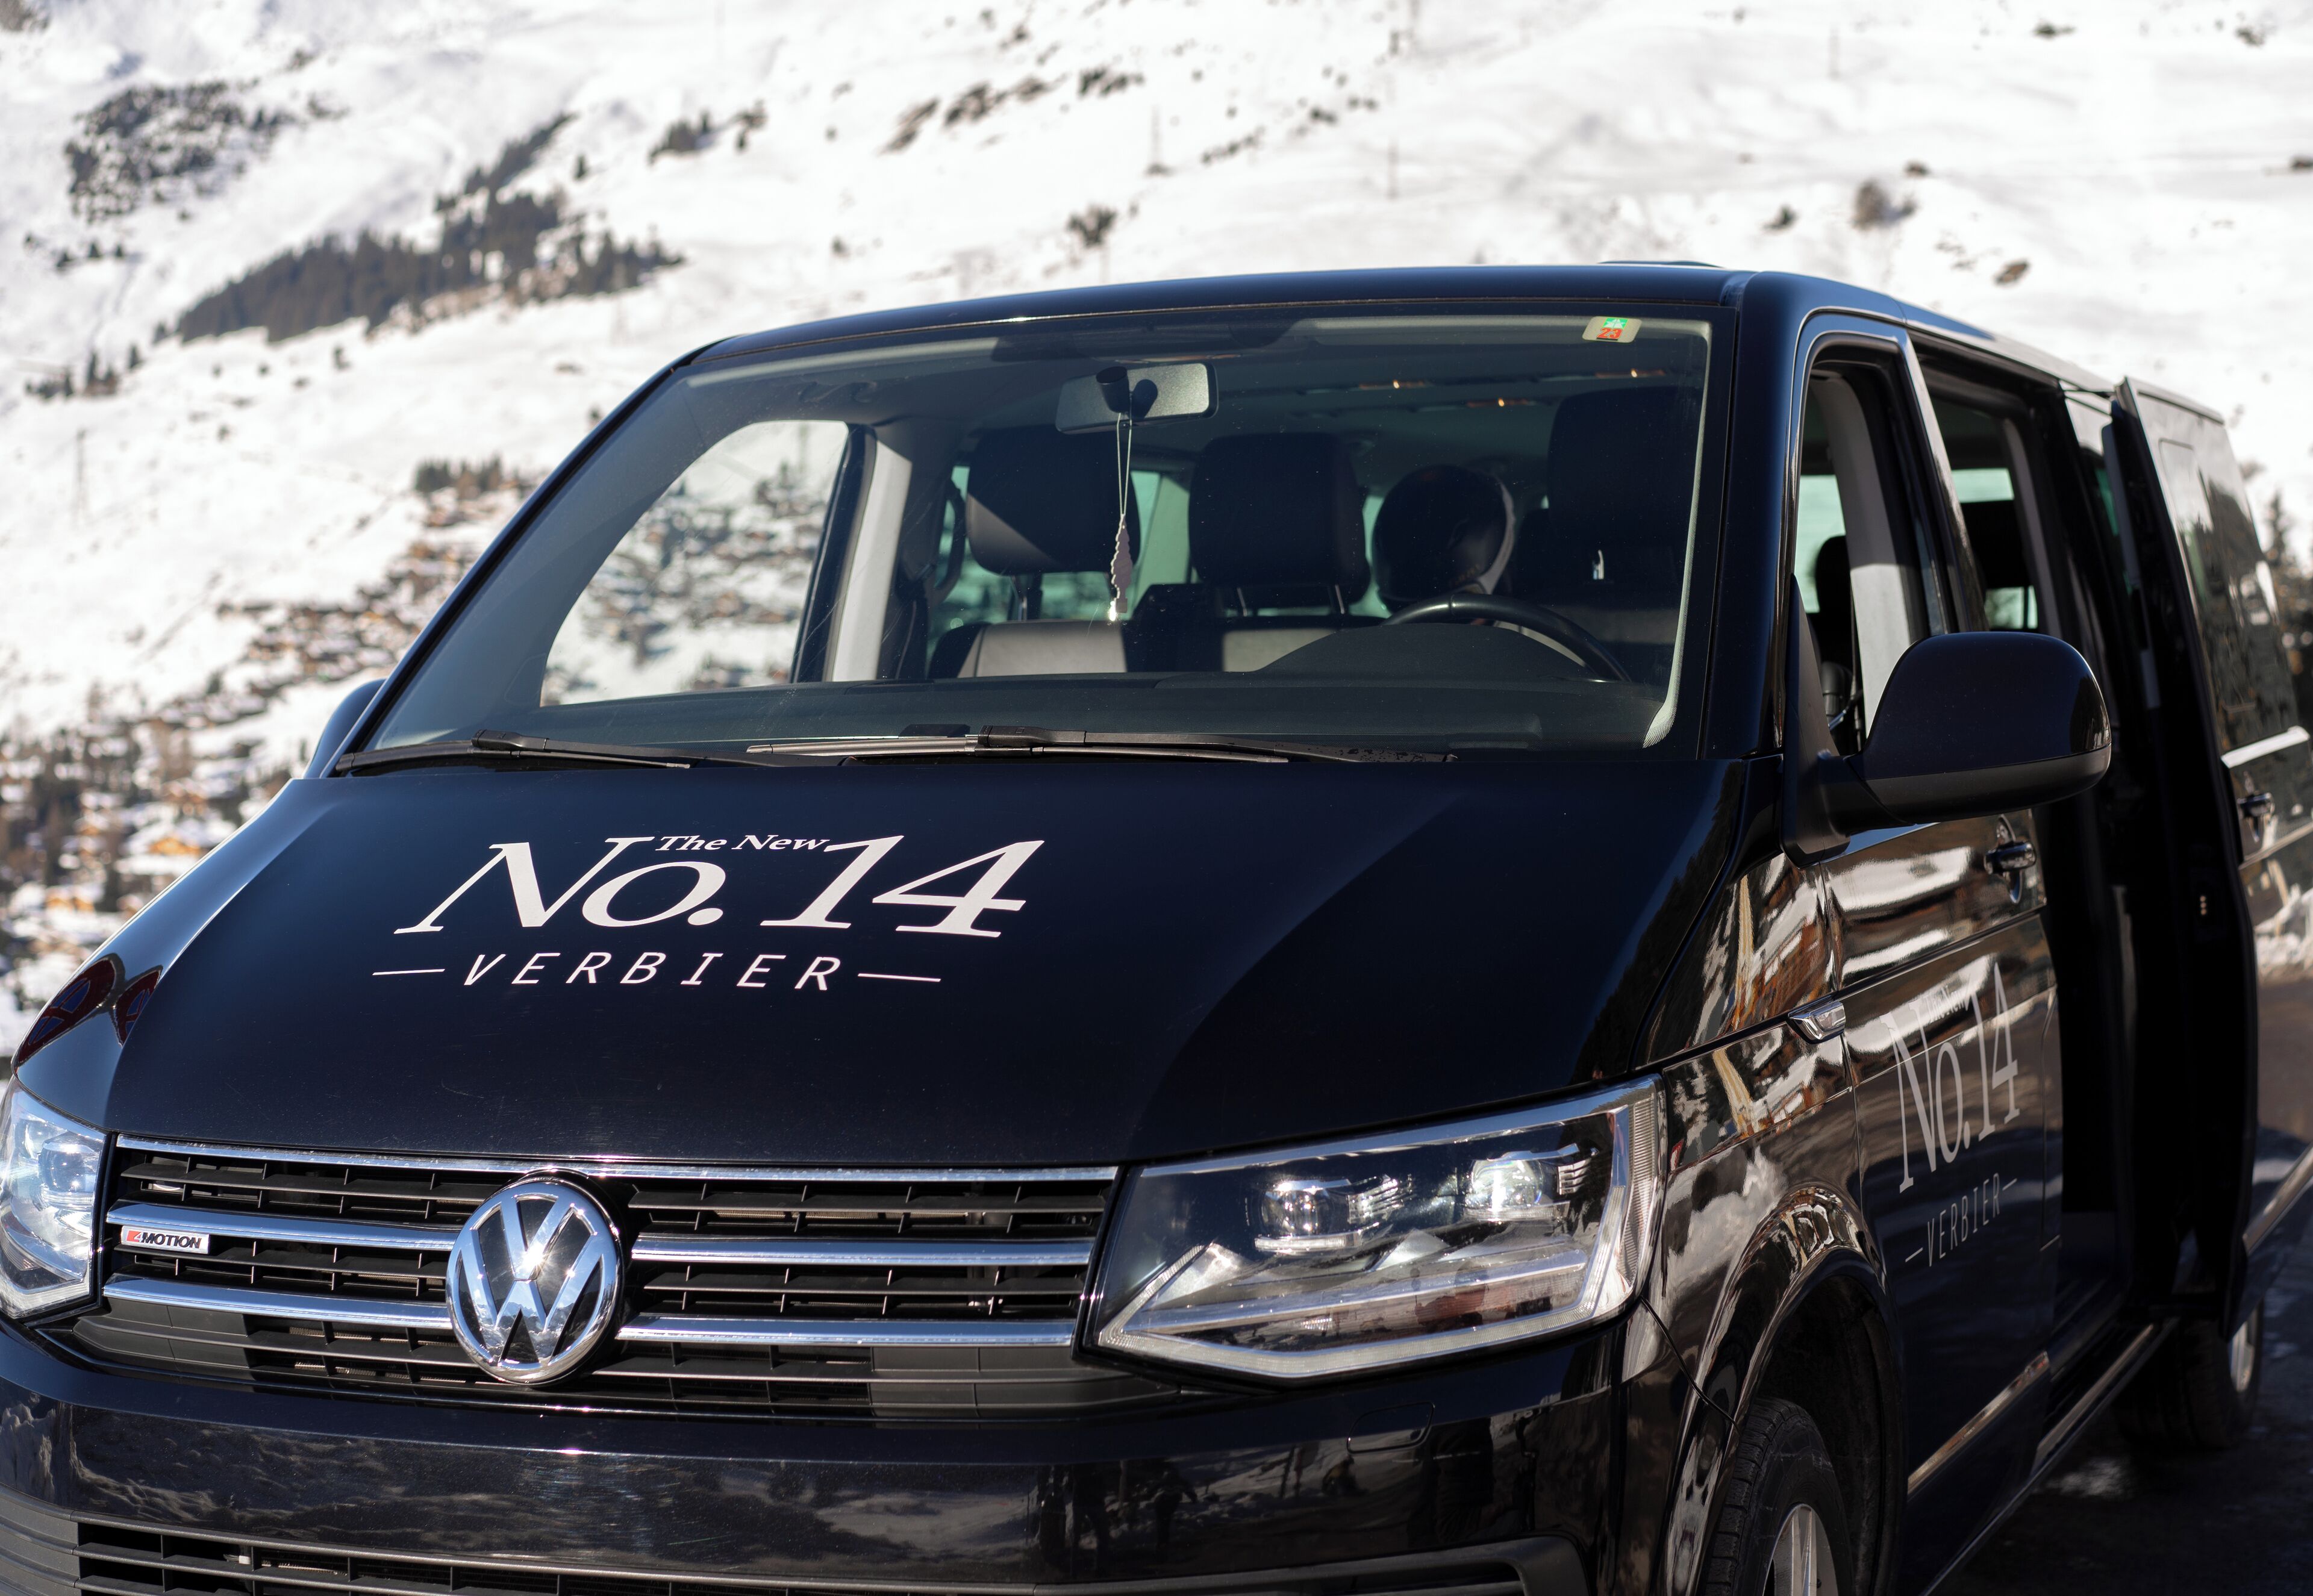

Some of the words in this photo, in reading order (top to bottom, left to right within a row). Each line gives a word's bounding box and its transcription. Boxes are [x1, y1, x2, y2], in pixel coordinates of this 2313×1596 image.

[1597, 327, 1623, 340] 23
[655, 834, 728, 851] The
[731, 834, 830, 850] New
[393, 835, 726, 935] No.
[760, 835, 1045, 938] 14
[463, 952, 841, 991] VERBIER
[1879, 996, 1971, 1193] No.
[1964, 961, 2020, 1141] 14
[1927, 1172, 2000, 1267] VERBIER
[127, 1230, 202, 1249] 4MOTION
